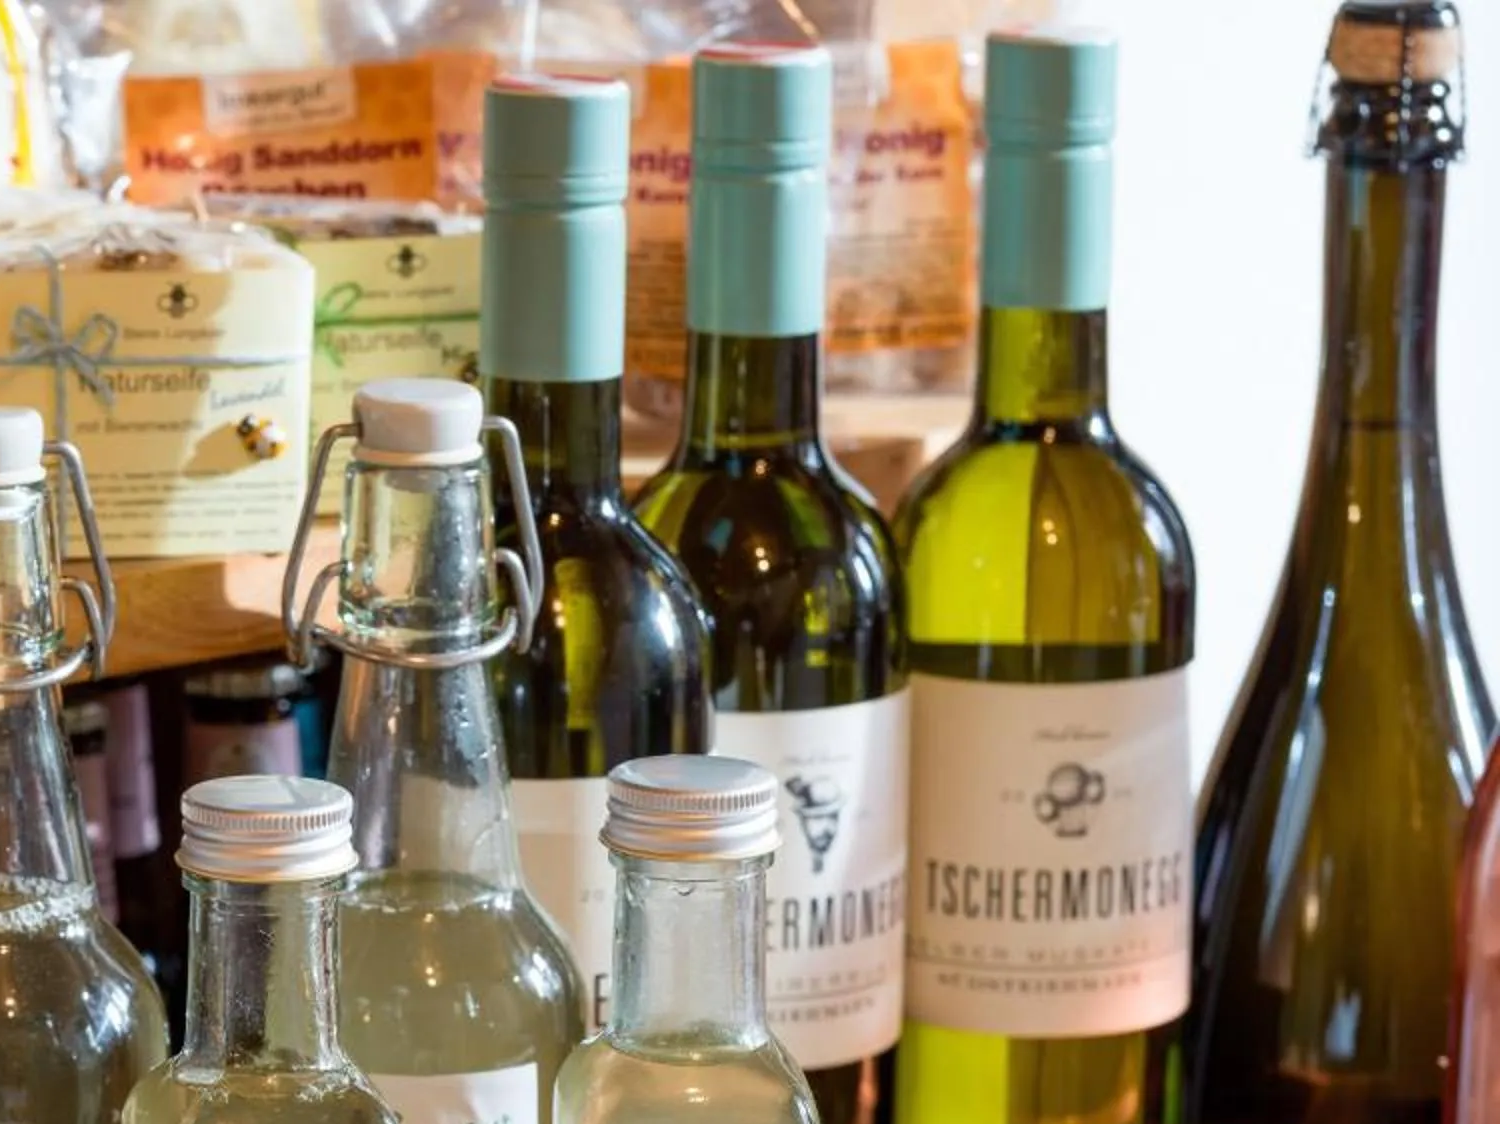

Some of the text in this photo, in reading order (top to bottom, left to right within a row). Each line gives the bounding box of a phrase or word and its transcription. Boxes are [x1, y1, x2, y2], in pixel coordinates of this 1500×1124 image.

[254, 136, 423, 170] Sanddorn
[630, 145, 692, 184] nig
[326, 323, 443, 353] aturseife
